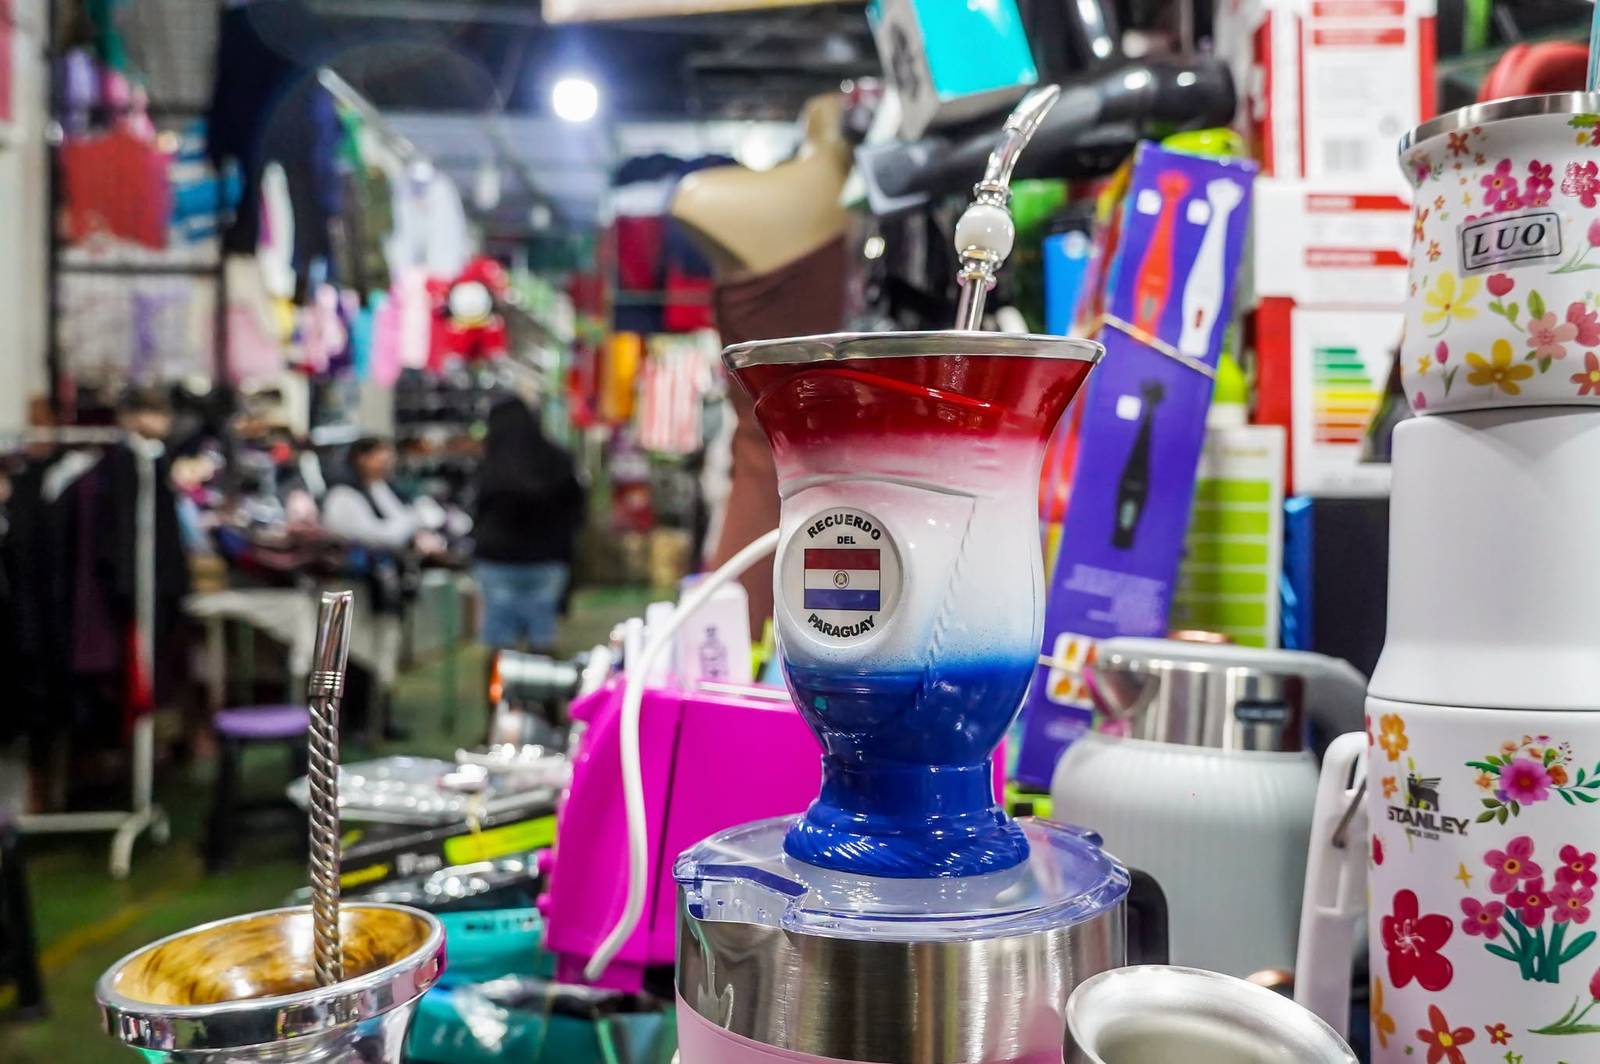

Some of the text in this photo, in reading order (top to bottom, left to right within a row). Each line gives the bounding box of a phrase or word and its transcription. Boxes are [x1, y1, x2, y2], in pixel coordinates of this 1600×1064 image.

[1472, 223, 1545, 256] LUO
[807, 514, 881, 540] RECUERDO
[837, 536, 856, 544] DEL
[808, 613, 875, 638] PARAGUAY
[1388, 806, 1469, 836] STANLEY
